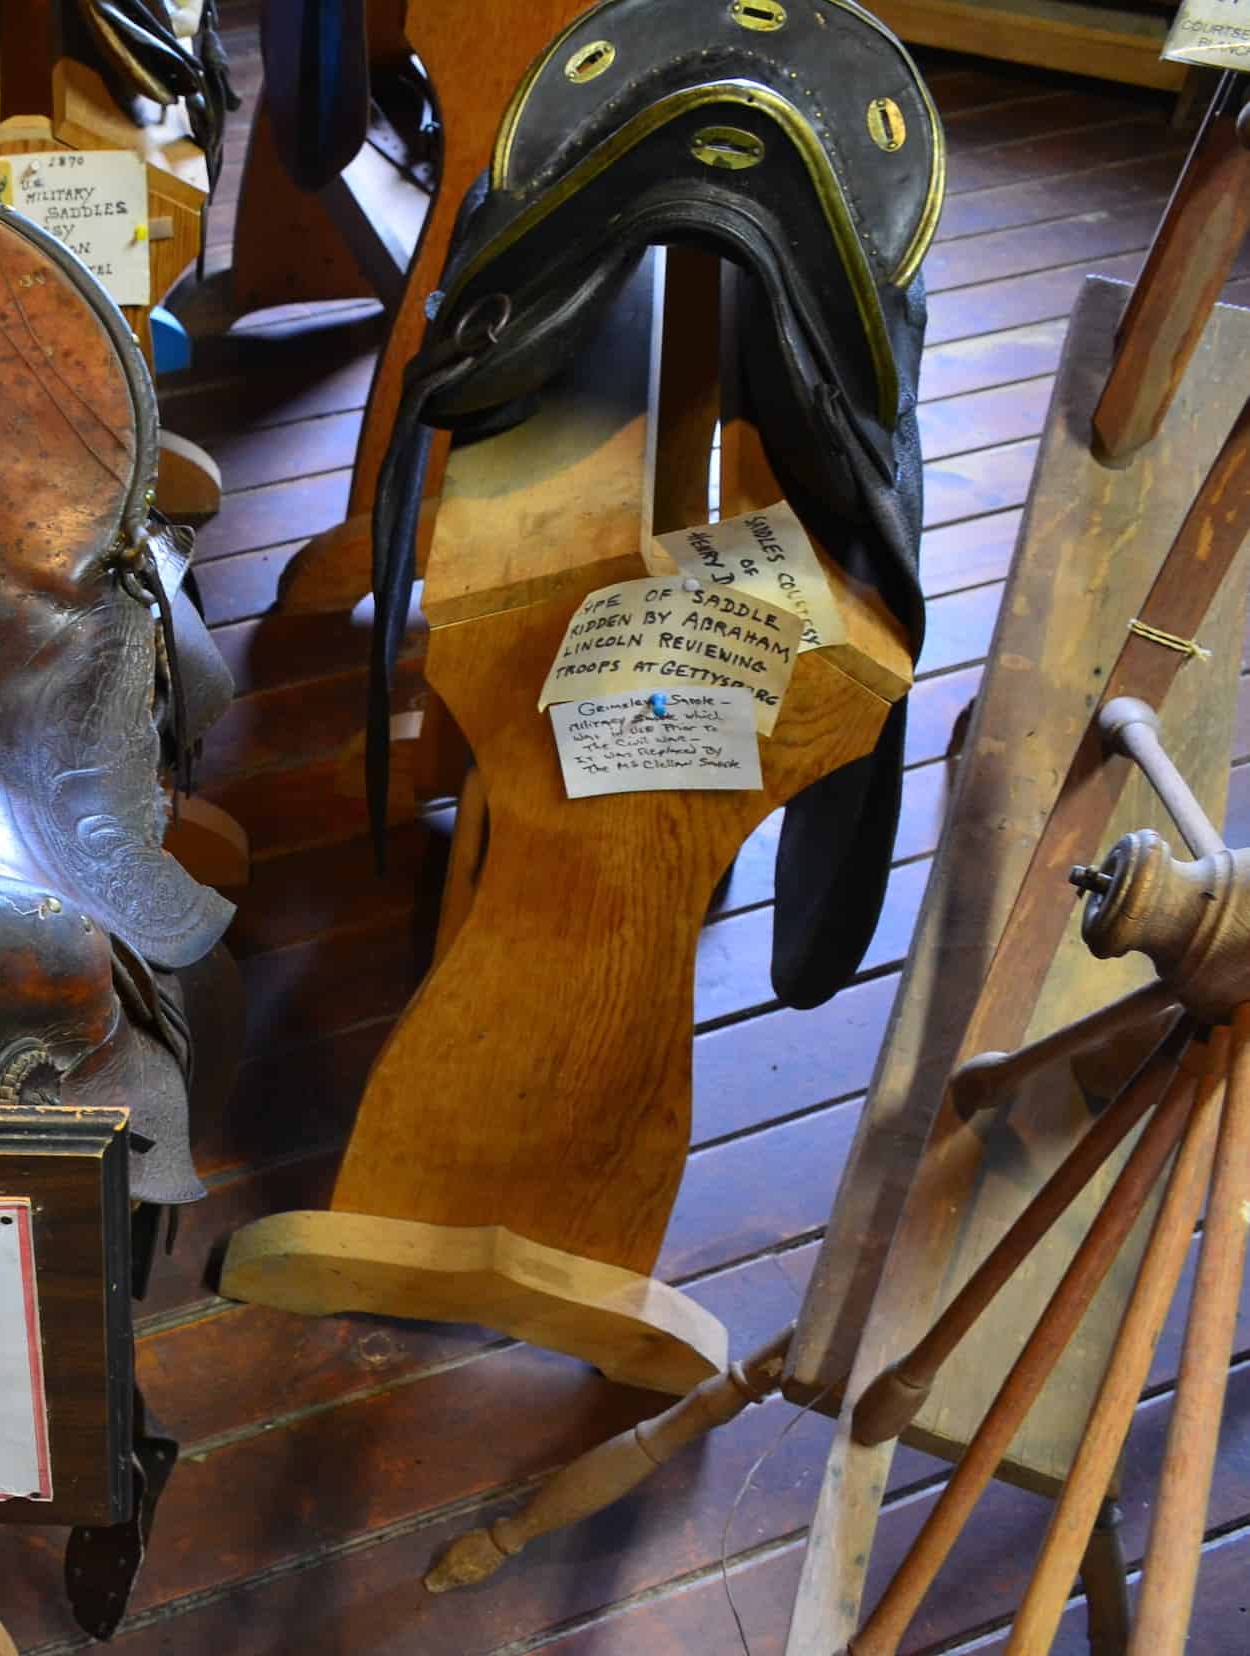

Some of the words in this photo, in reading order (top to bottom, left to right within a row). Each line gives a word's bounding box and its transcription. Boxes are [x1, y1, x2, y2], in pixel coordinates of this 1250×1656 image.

[25, 186, 95, 207] MILITARY
[46, 200, 129, 220] SADDLES
[686, 531, 726, 568] HENRY
[739, 558, 759, 576] OF
[645, 588, 673, 602] OF
[692, 589, 782, 632] SADDLE
[562, 632, 644, 658] LINCOLN
[659, 632, 767, 674] REVIEWING
[569, 613, 633, 640] RIDDEN
[643, 610, 673, 625] BY
[681, 611, 791, 664] ABRAHAM
[555, 659, 622, 680] TROOPS
[632, 660, 660, 673] AT
[659, 660, 780, 707] GETTYSBRG
